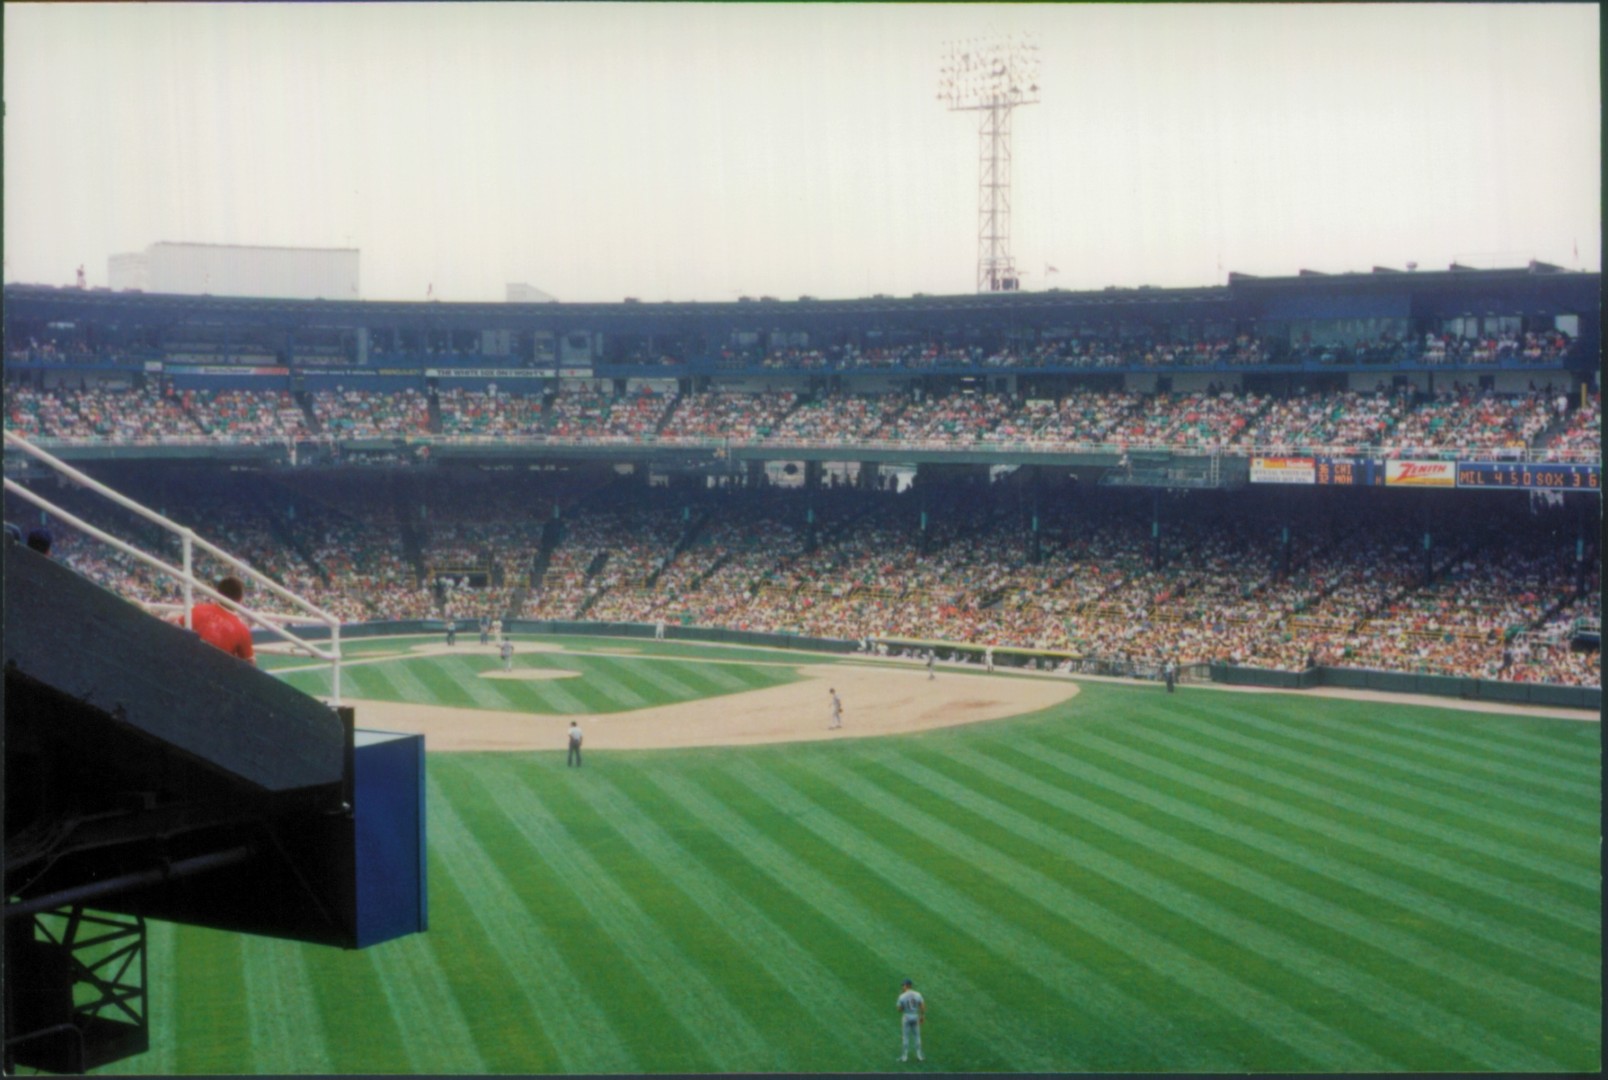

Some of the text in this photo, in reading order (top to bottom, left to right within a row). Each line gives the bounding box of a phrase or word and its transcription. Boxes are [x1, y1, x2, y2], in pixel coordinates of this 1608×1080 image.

[1334, 464, 1352, 474] CHI
[1460, 471, 1485, 485] MIL
[1494, 472, 1503, 484] 4
[1536, 472, 1564, 487] SOX
[1572, 473, 1581, 488] 3
[1588, 474, 1598, 488] 6
